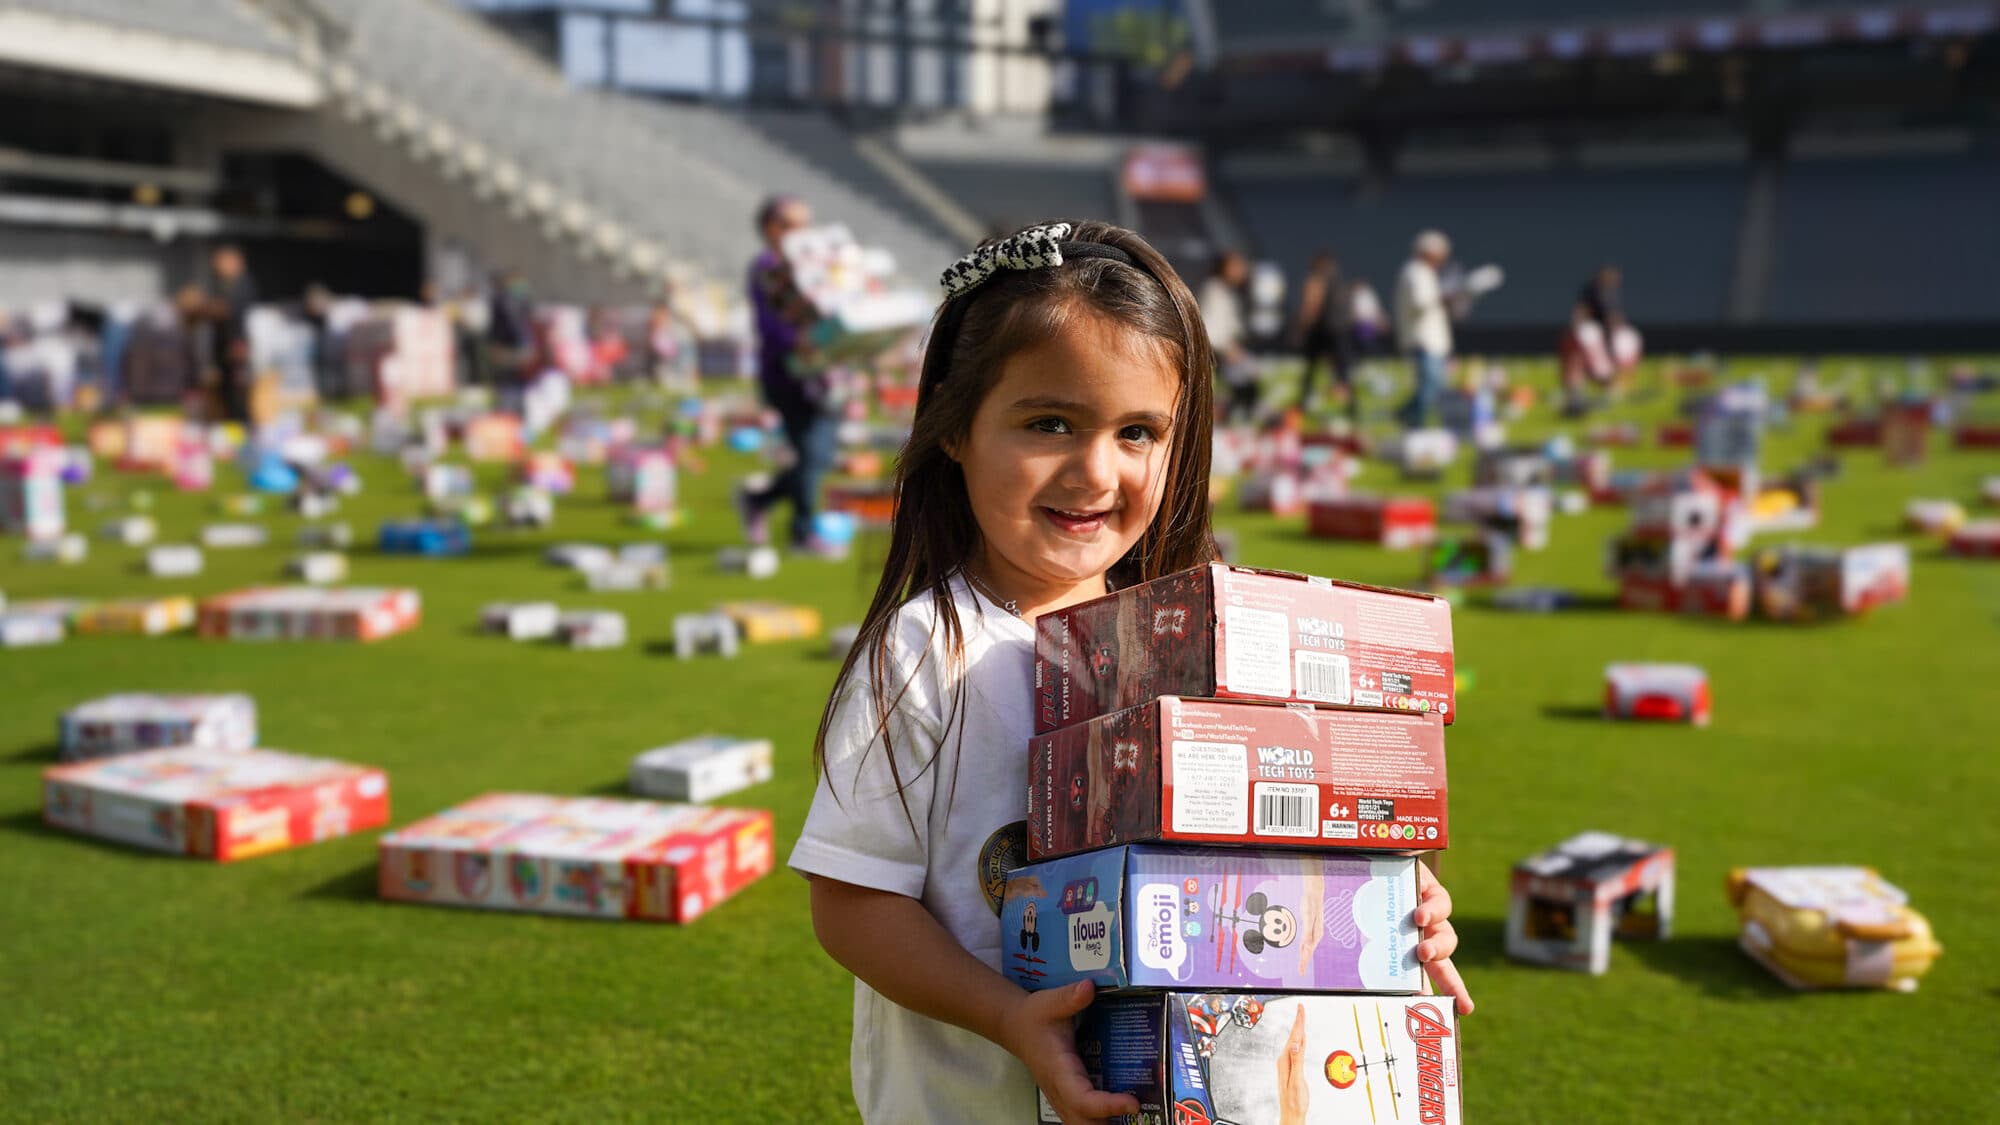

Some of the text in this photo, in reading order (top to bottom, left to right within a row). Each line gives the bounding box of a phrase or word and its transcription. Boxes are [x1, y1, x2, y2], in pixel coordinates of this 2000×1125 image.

[1297, 616, 1344, 638] WORLD
[1299, 634, 1345, 650] TECH TOYS
[1359, 675, 1376, 689] 6+
[1257, 746, 1314, 766] WORLD
[1258, 765, 1285, 778] TECH
[1287, 767, 1315, 779] TOYS
[1330, 802, 1349, 818] 6+
[991, 842, 1007, 881] POLICE
[1073, 917, 1105, 950] emoji
[1153, 894, 1177, 959] emoji
[1388, 927, 1398, 977] Mickey
[1180, 1043, 1203, 1089] IRON MAN
[1405, 1002, 1453, 1125] AVENGERS
